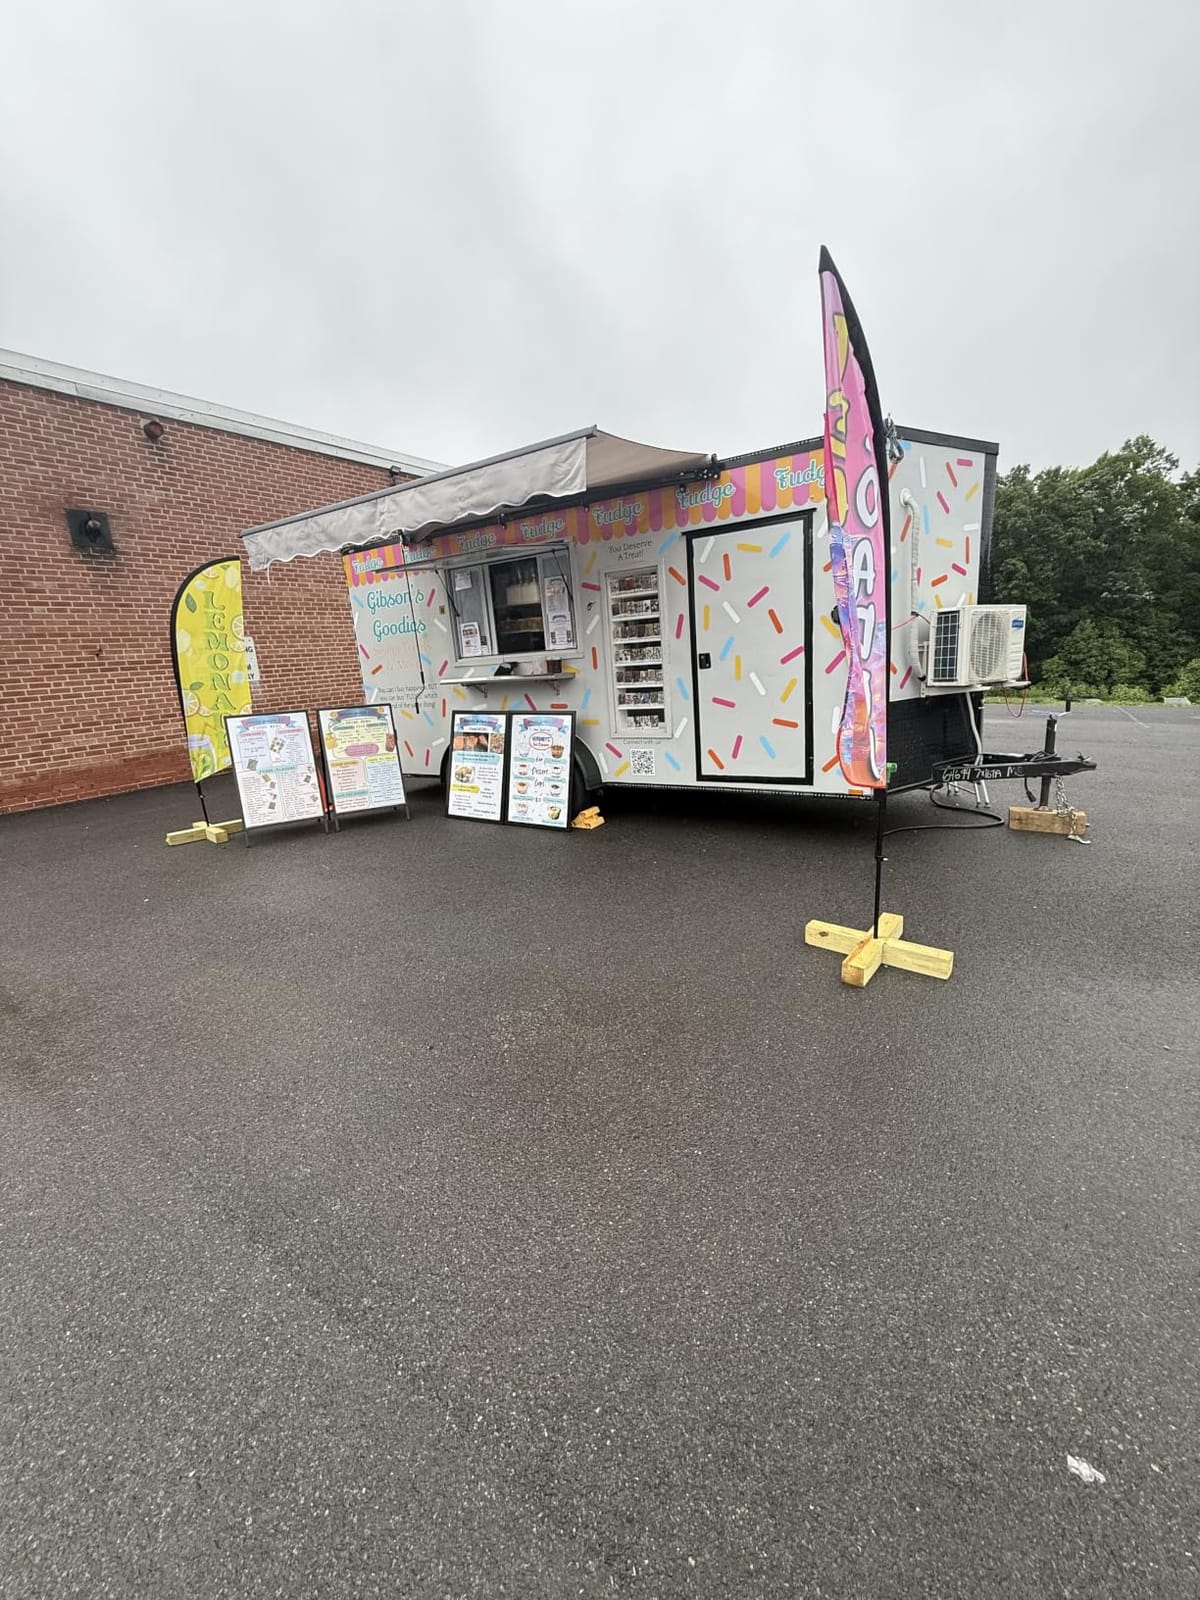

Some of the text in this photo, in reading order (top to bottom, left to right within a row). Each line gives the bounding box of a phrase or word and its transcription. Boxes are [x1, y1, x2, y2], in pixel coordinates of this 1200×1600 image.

[520, 517, 565, 539] Fudge
[593, 499, 644, 526] Fudge
[676, 482, 736, 509] Fudge
[774, 459, 825, 489] Fudg
[608, 540, 652, 553] You Deserve
[367, 584, 424, 615] Gibson's
[373, 616, 426, 642] Goodies
